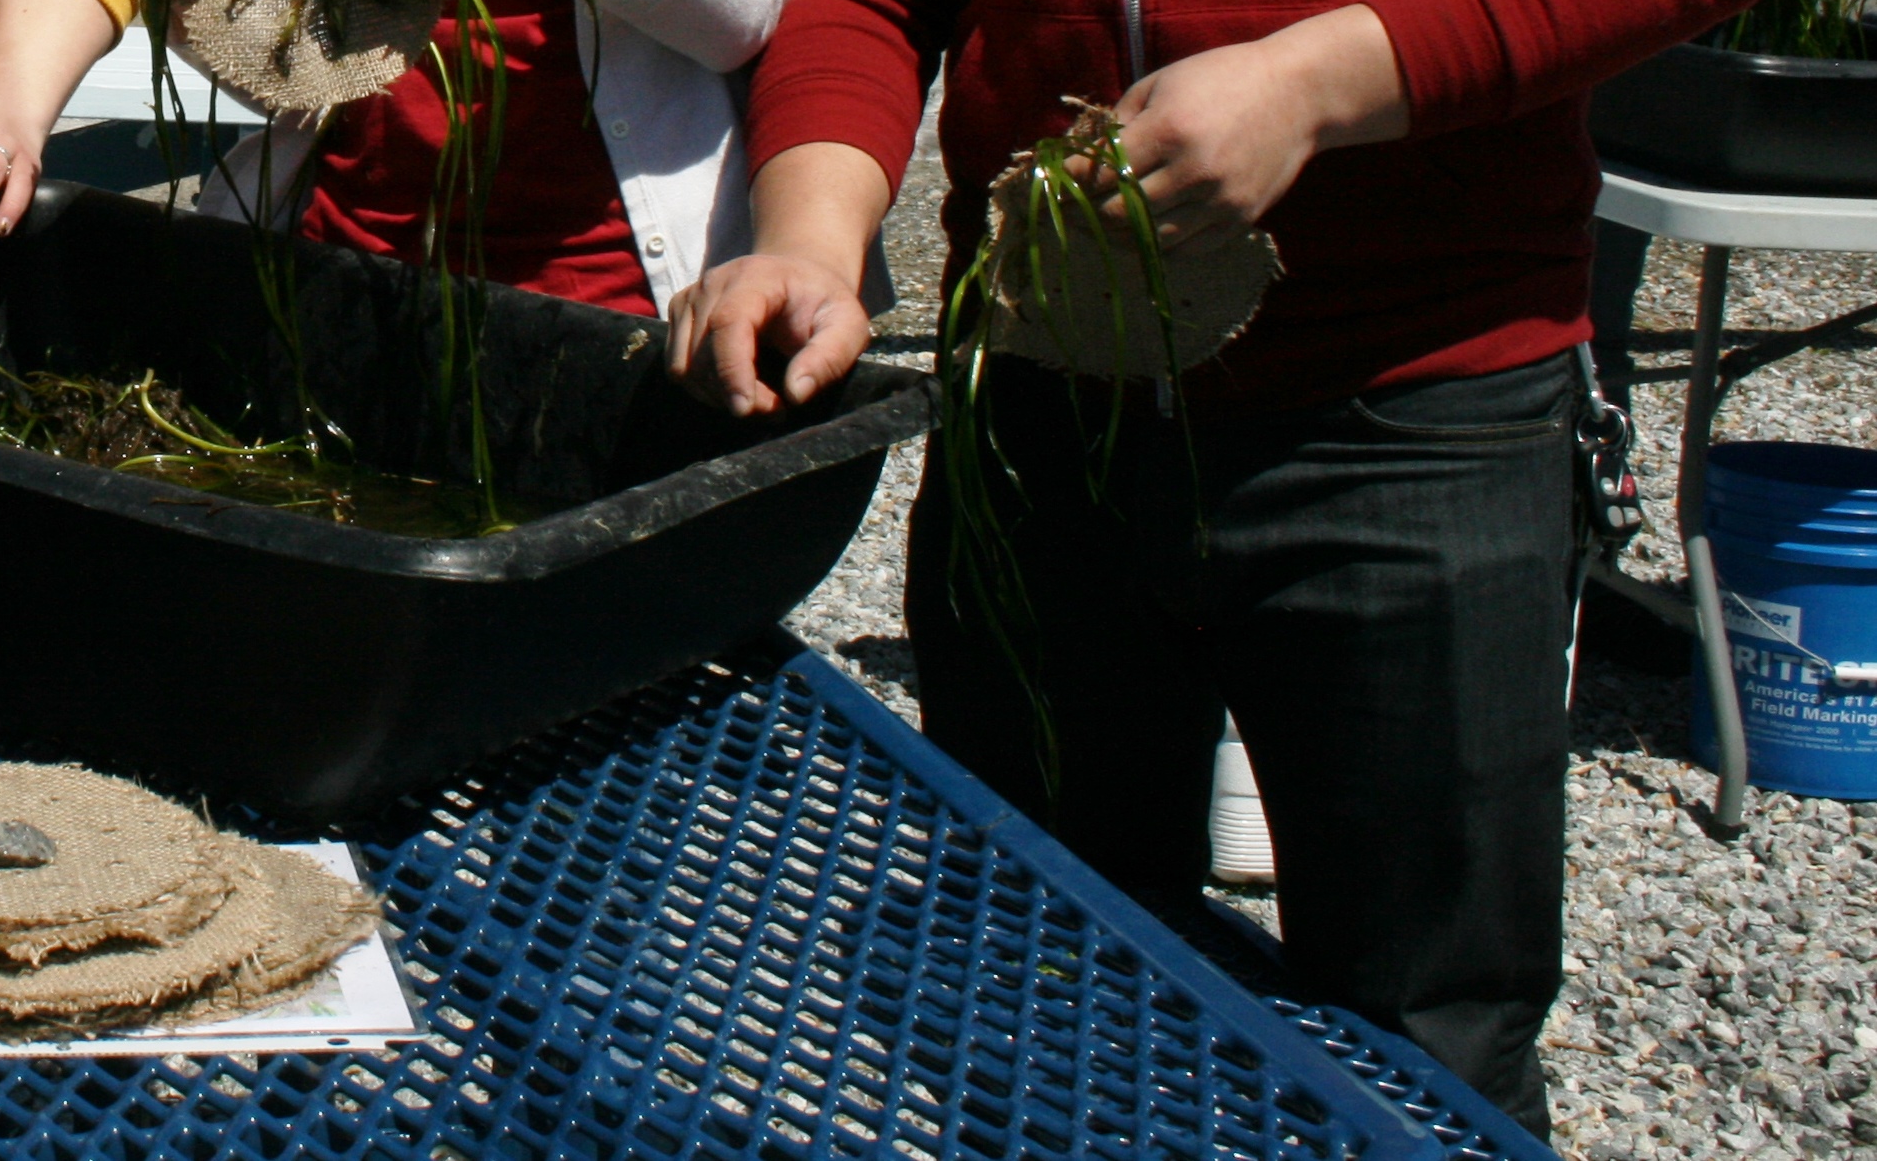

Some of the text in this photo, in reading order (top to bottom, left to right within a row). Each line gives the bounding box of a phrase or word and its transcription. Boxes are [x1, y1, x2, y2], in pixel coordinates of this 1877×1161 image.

[1730, 644, 1825, 686] RITE
[1751, 697, 1796, 719] Field
[1802, 706, 1877, 727] Marking
